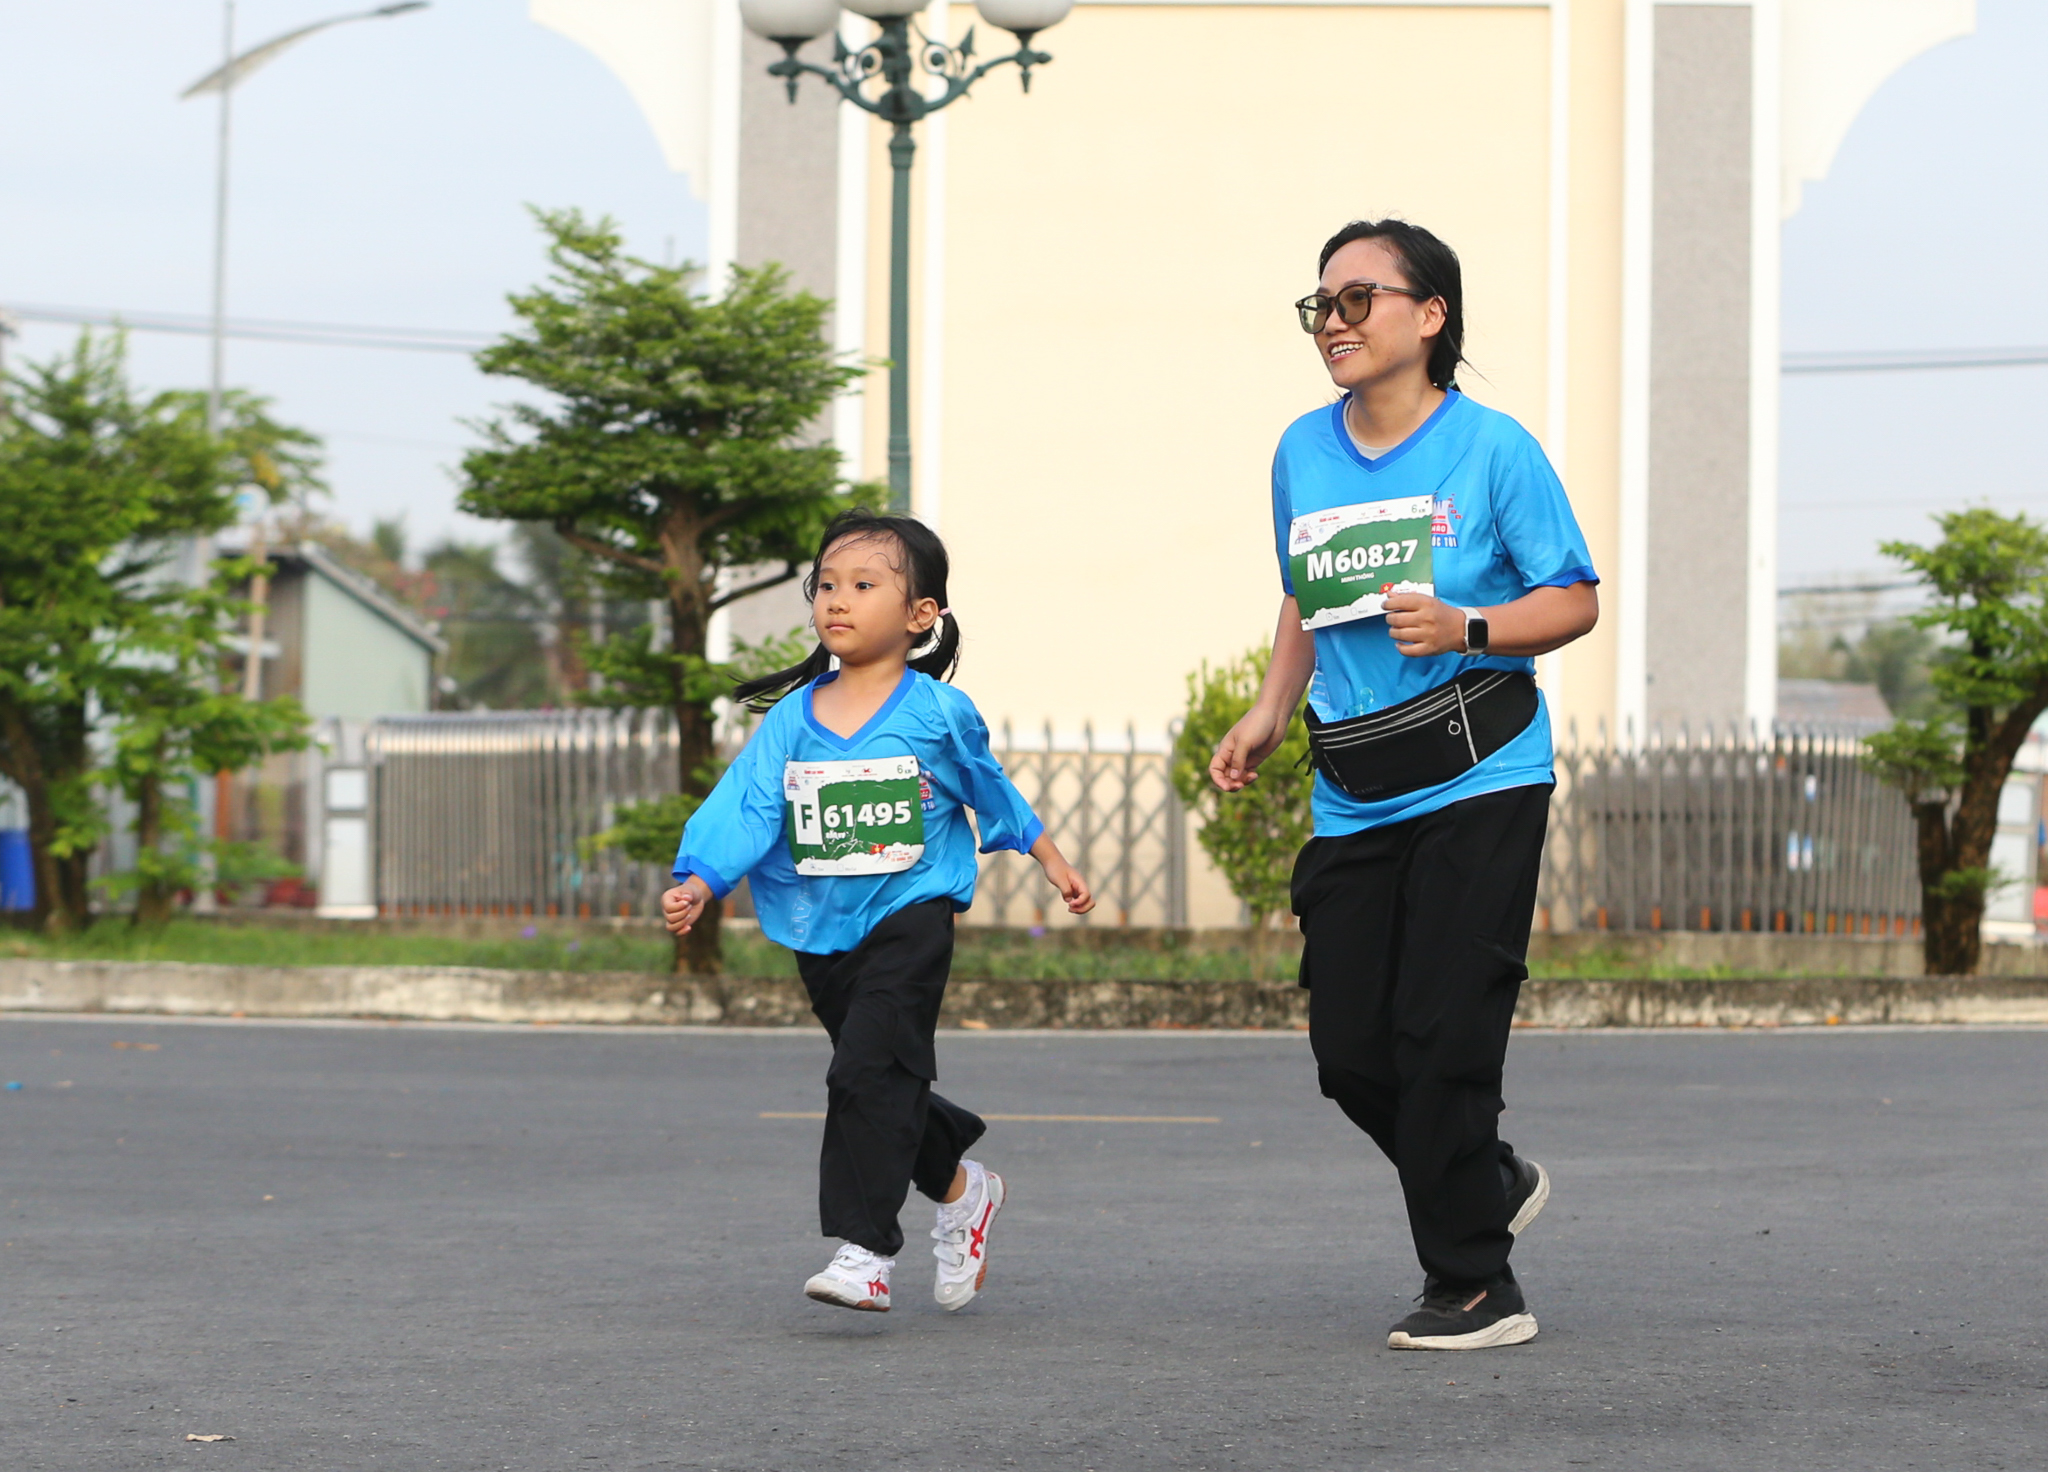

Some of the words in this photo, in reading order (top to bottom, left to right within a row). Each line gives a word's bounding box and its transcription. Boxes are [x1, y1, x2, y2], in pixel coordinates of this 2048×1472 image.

[1411, 504, 1418, 513] 6
[896, 764, 903, 775] 6
[823, 800, 912, 829] 61495
